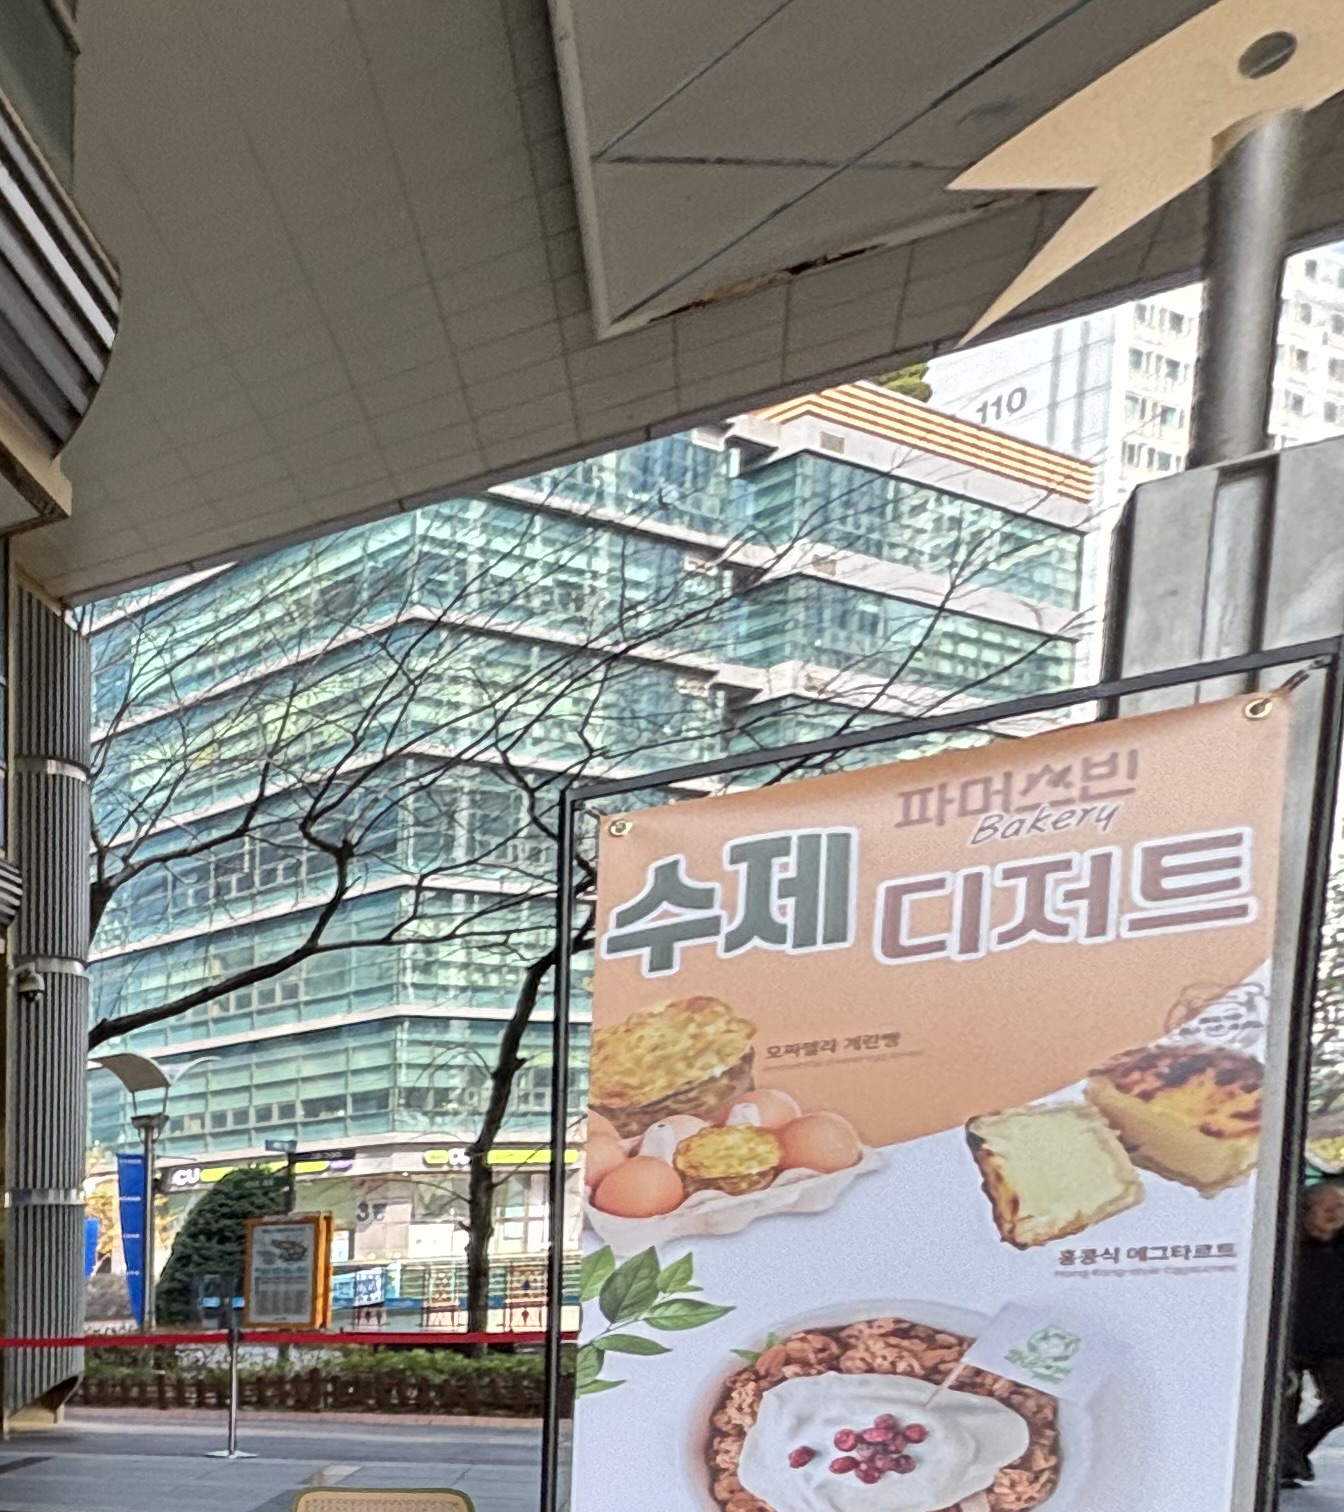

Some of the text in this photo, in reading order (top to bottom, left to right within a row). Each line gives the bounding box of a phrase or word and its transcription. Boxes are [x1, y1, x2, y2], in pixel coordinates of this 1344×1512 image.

[975, 387, 1028, 424] 110
[894, 749, 1139, 831] 파머스빈
[969, 804, 1122, 847] Bakery
[602, 825, 1259, 978] 수제 디저트
[171, 1167, 201, 1186] CU
[1125, 1242, 1238, 1262] 에그타르트
